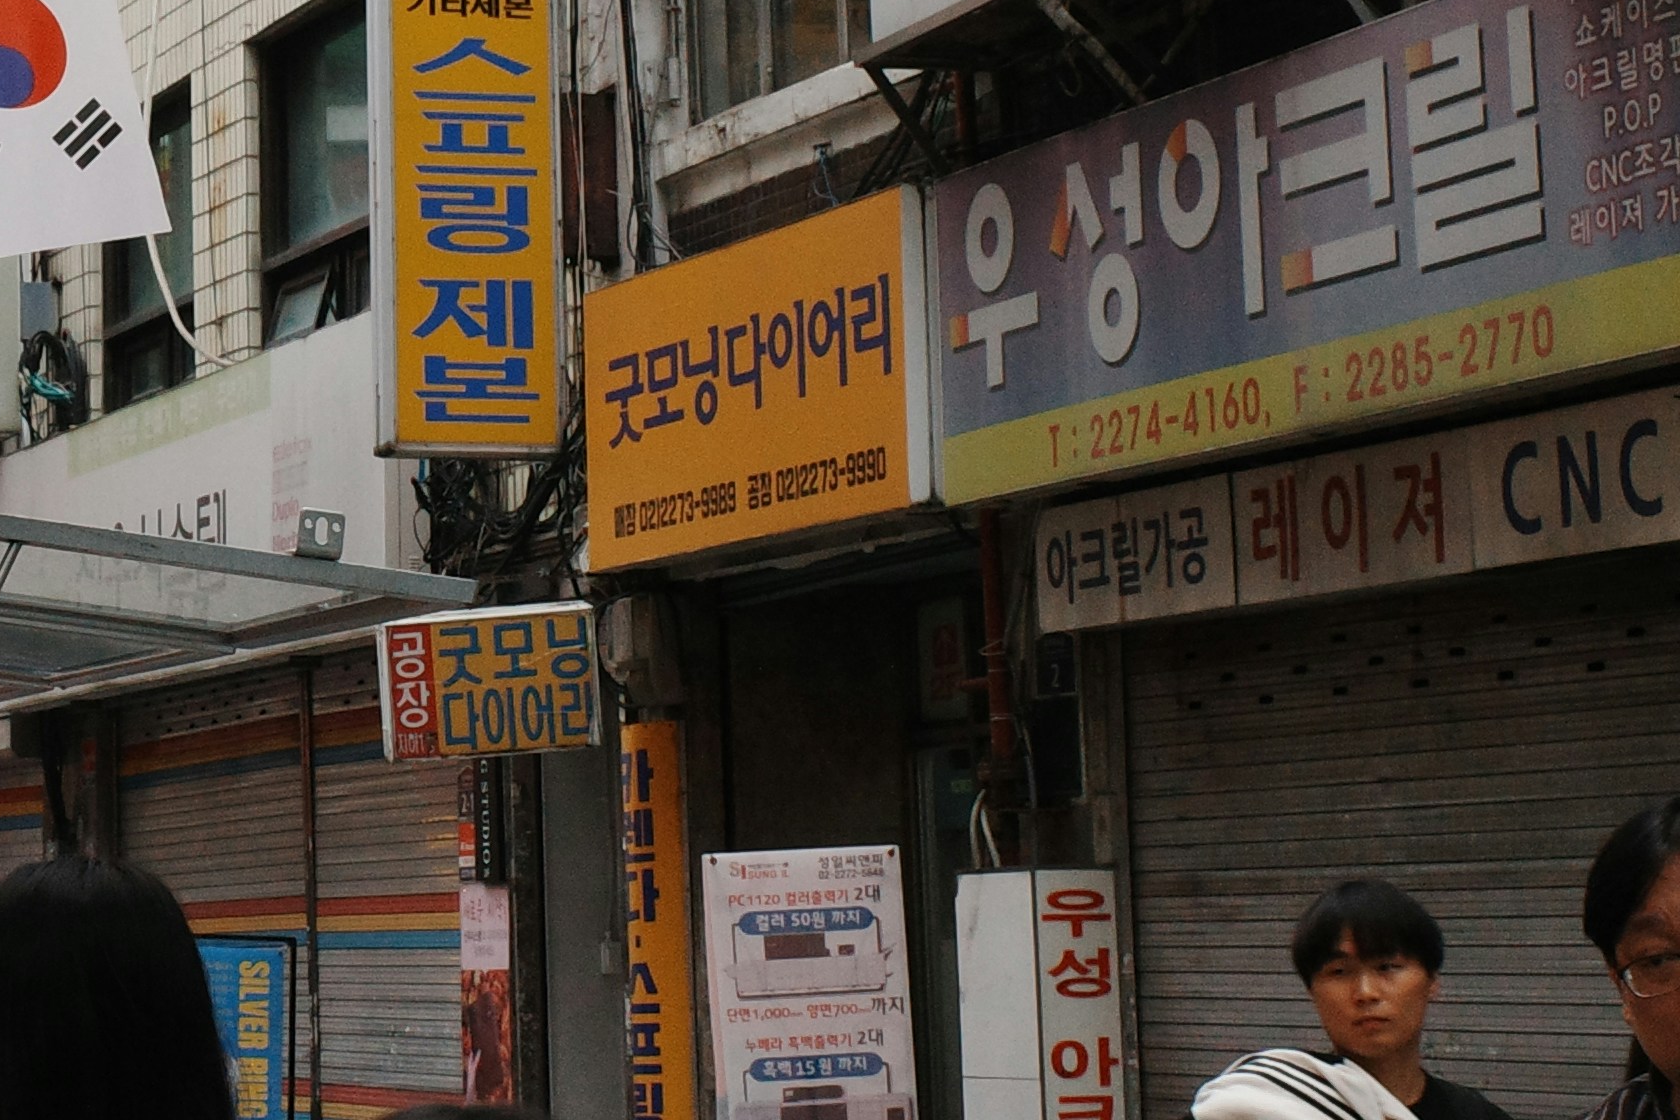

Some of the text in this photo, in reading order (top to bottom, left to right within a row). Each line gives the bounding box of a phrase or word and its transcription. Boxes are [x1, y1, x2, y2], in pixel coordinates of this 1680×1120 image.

[1604, 92, 1661, 139] P.O.P
[949, 4, 1547, 393] 우성아크릴
[605, 272, 892, 450] 굿모닝다이어리
[1346, 304, 1556, 405] 2285-2770
[747, 473, 773, 510] 공장
[776, 446, 887, 501] 02)2273-9990
[1046, 505, 1209, 605] 아크릴가공
[1501, 418, 1665, 536] CNC
[391, 632, 430, 730] 공장
[438, 616, 591, 688] 굿모닝
[442, 681, 595, 750] 다이어리
[238, 959, 271, 1051] SILVER
